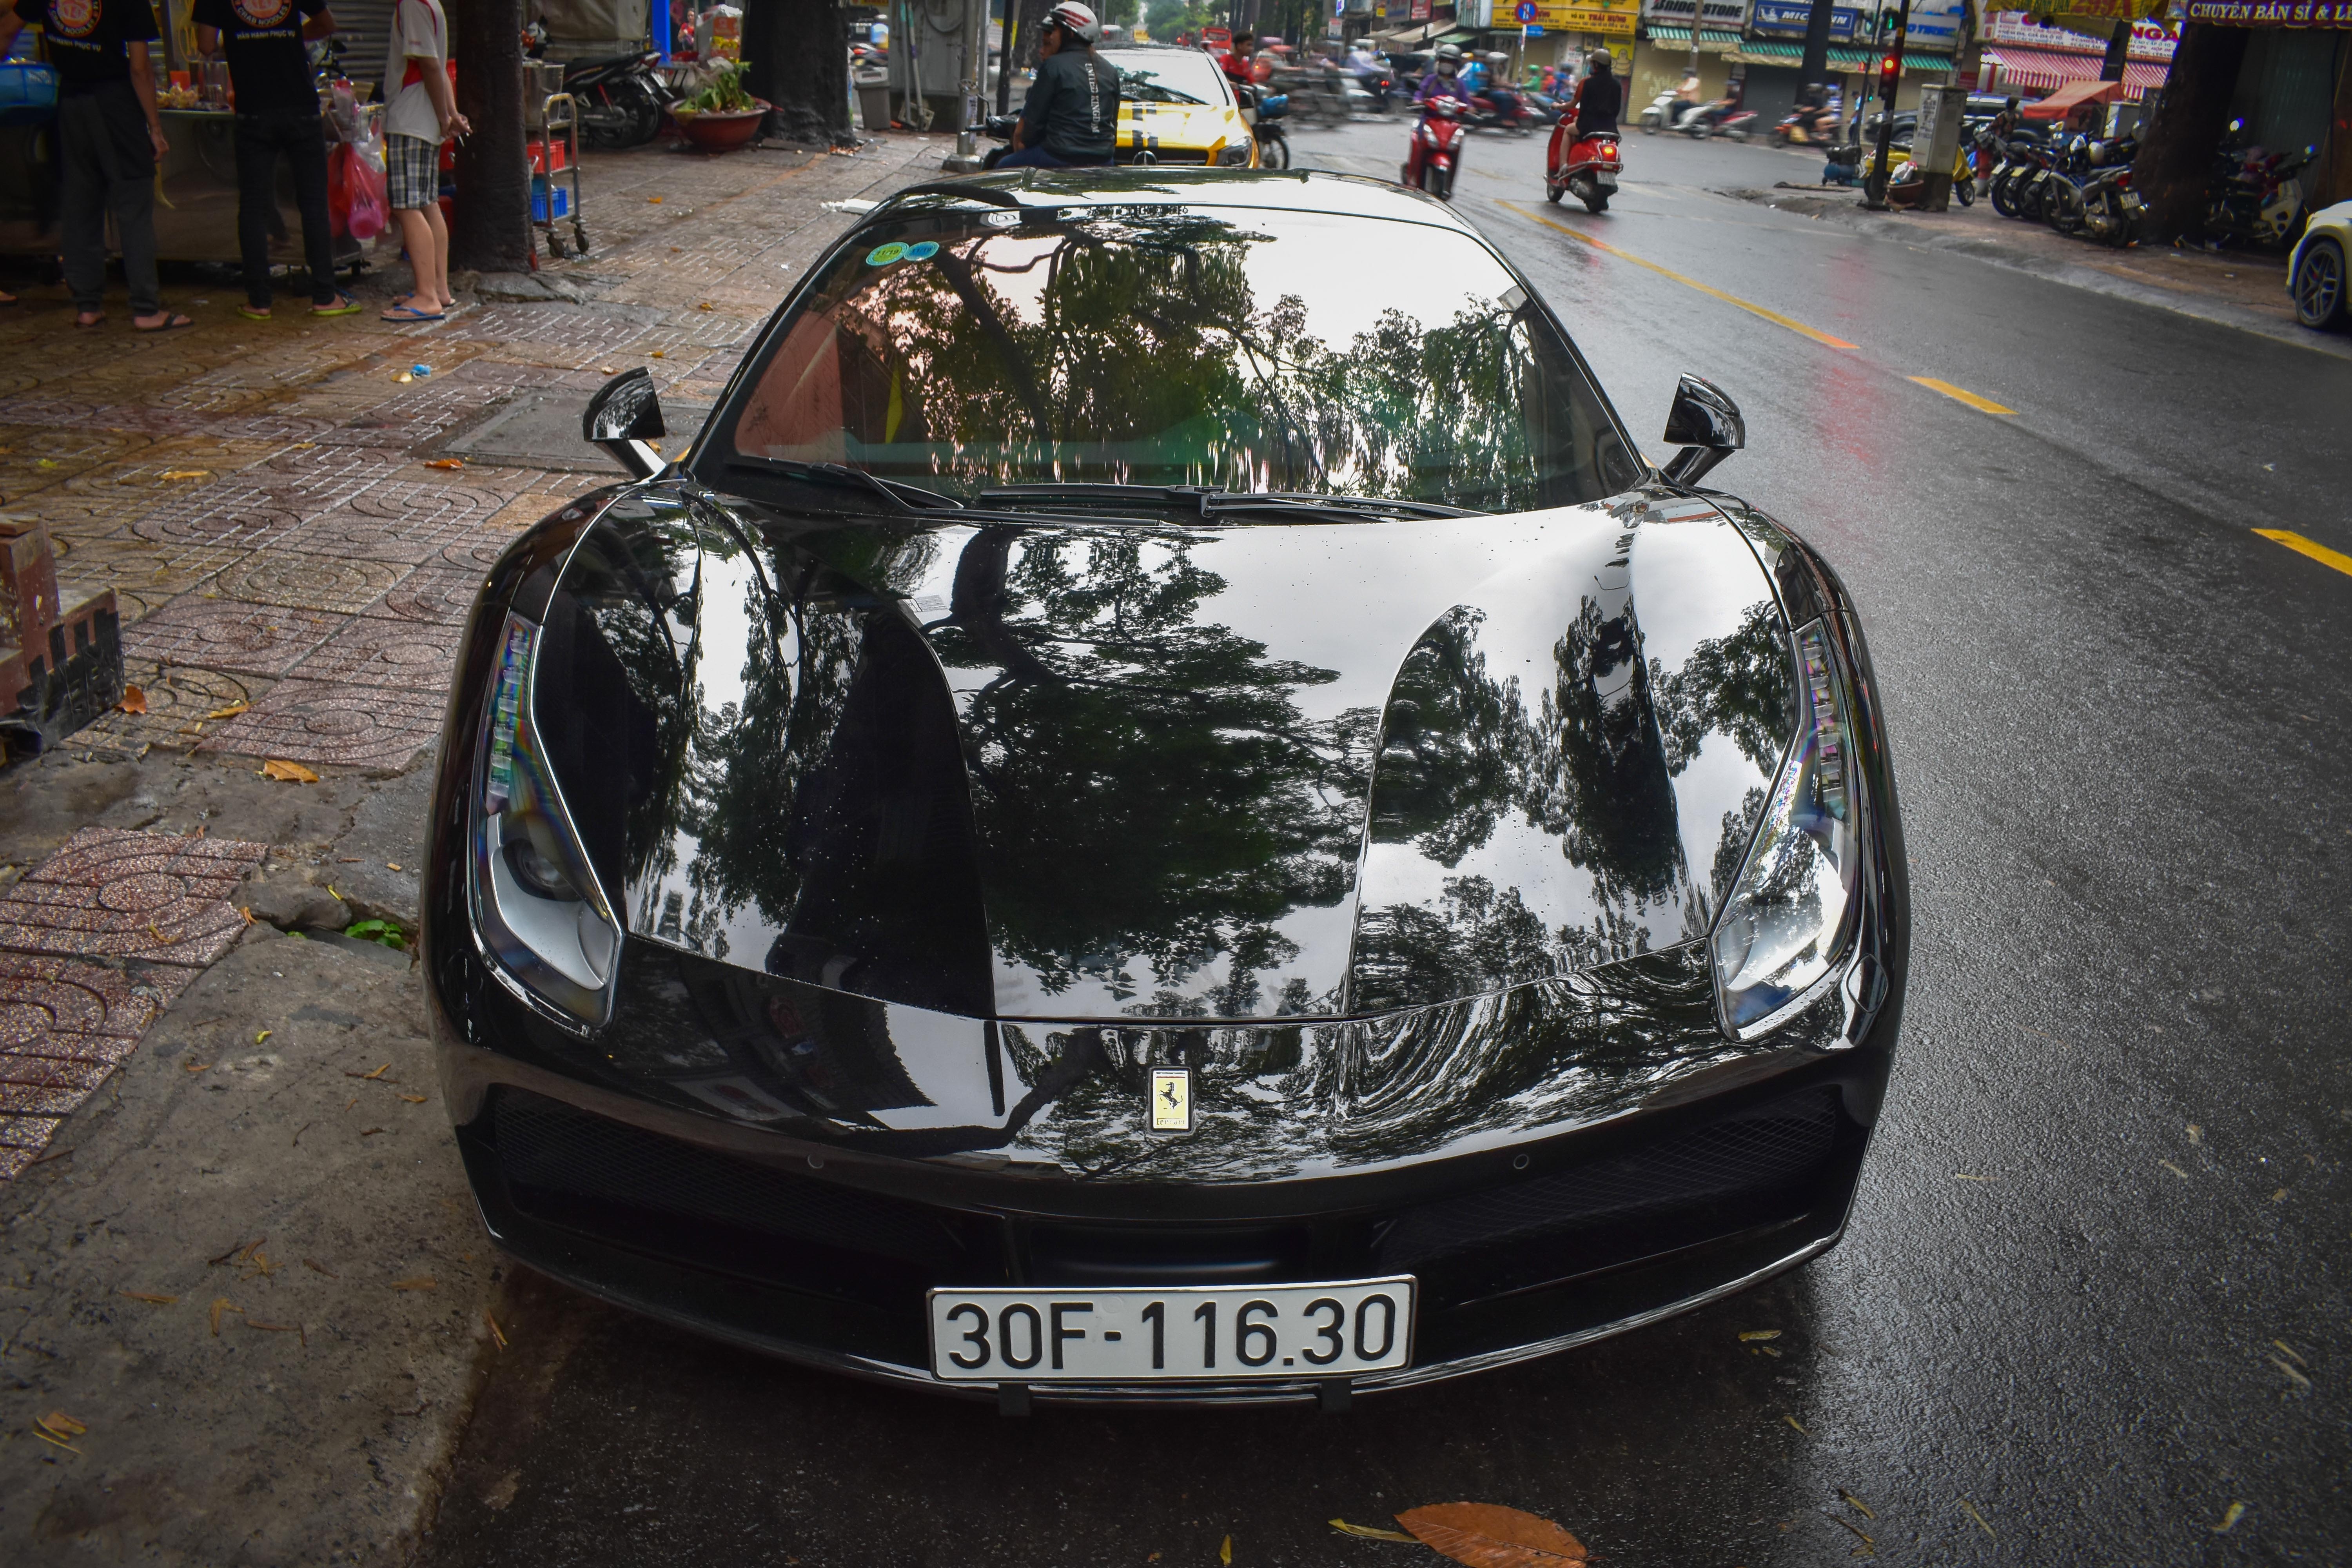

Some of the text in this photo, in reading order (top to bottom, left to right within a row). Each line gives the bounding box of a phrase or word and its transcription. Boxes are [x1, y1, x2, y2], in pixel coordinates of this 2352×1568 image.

[1651, 0, 1744, 18] BRIDGSTONE
[1782, 10, 1847, 25] MICIN
[2190, 1, 2251, 19] CHUYÊN
[2253, 0, 2289, 20] BÁN
[2294, 0, 2312, 20] SỈ
[2315, 5, 2332, 20] &
[1085, 63, 1101, 132] UNITED KINGDM
[946, 1293, 1396, 1370] 30F-116.30
